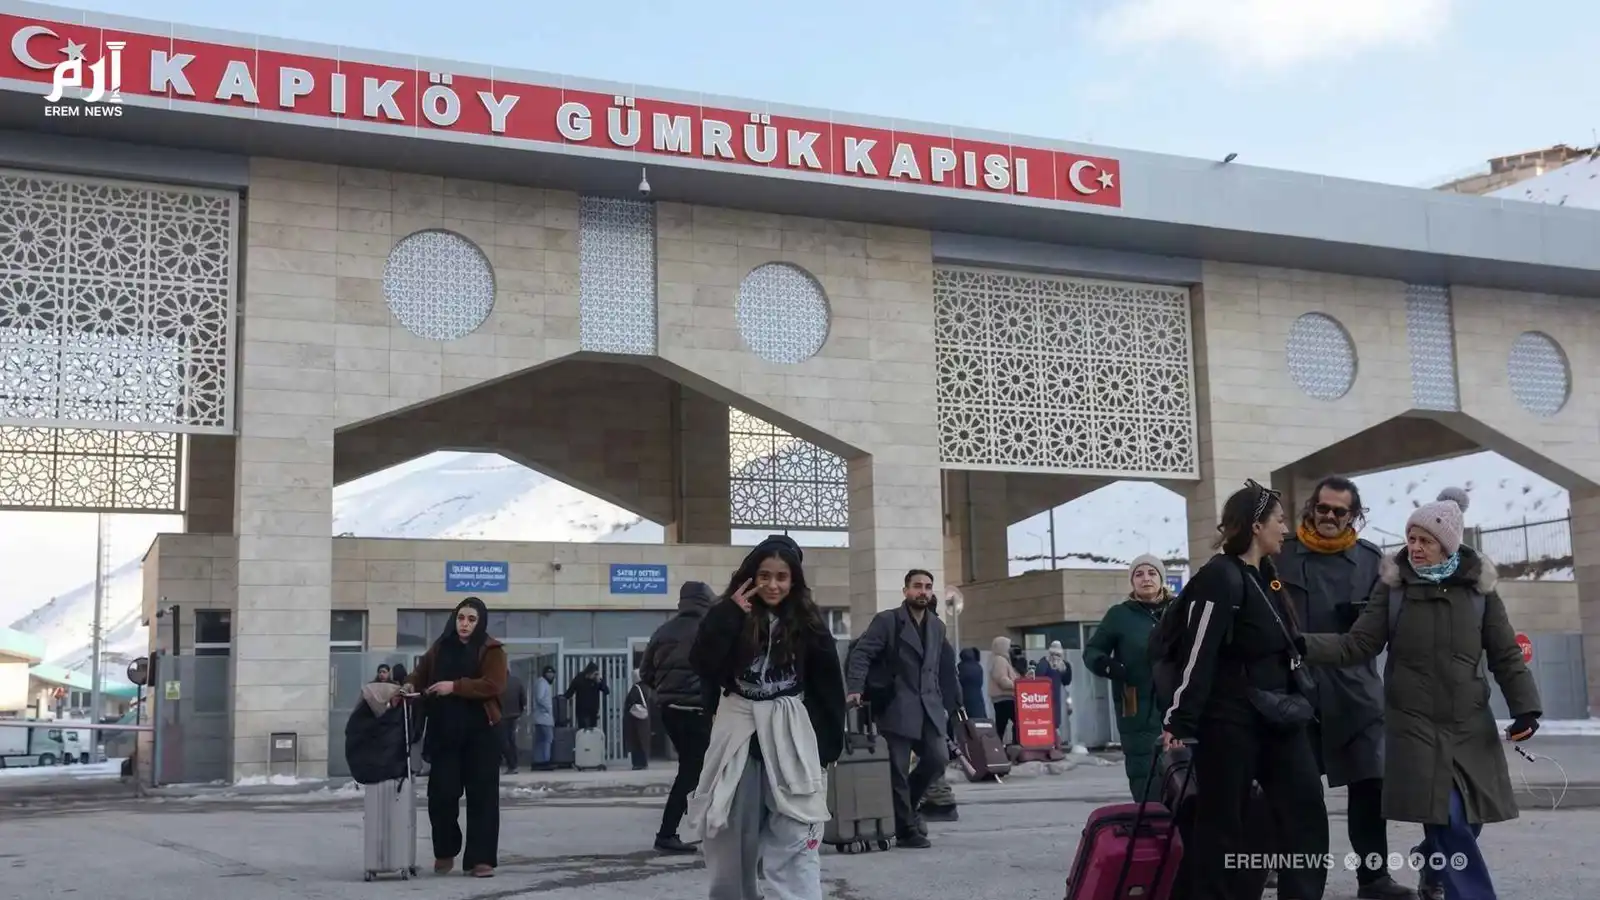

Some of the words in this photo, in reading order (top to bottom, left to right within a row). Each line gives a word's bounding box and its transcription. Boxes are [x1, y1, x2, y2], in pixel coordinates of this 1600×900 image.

[150, 50, 520, 133] KAPIKÖY
[556, 96, 823, 169] GÜMRÜK
[844, 136, 1029, 193] KAPISI
